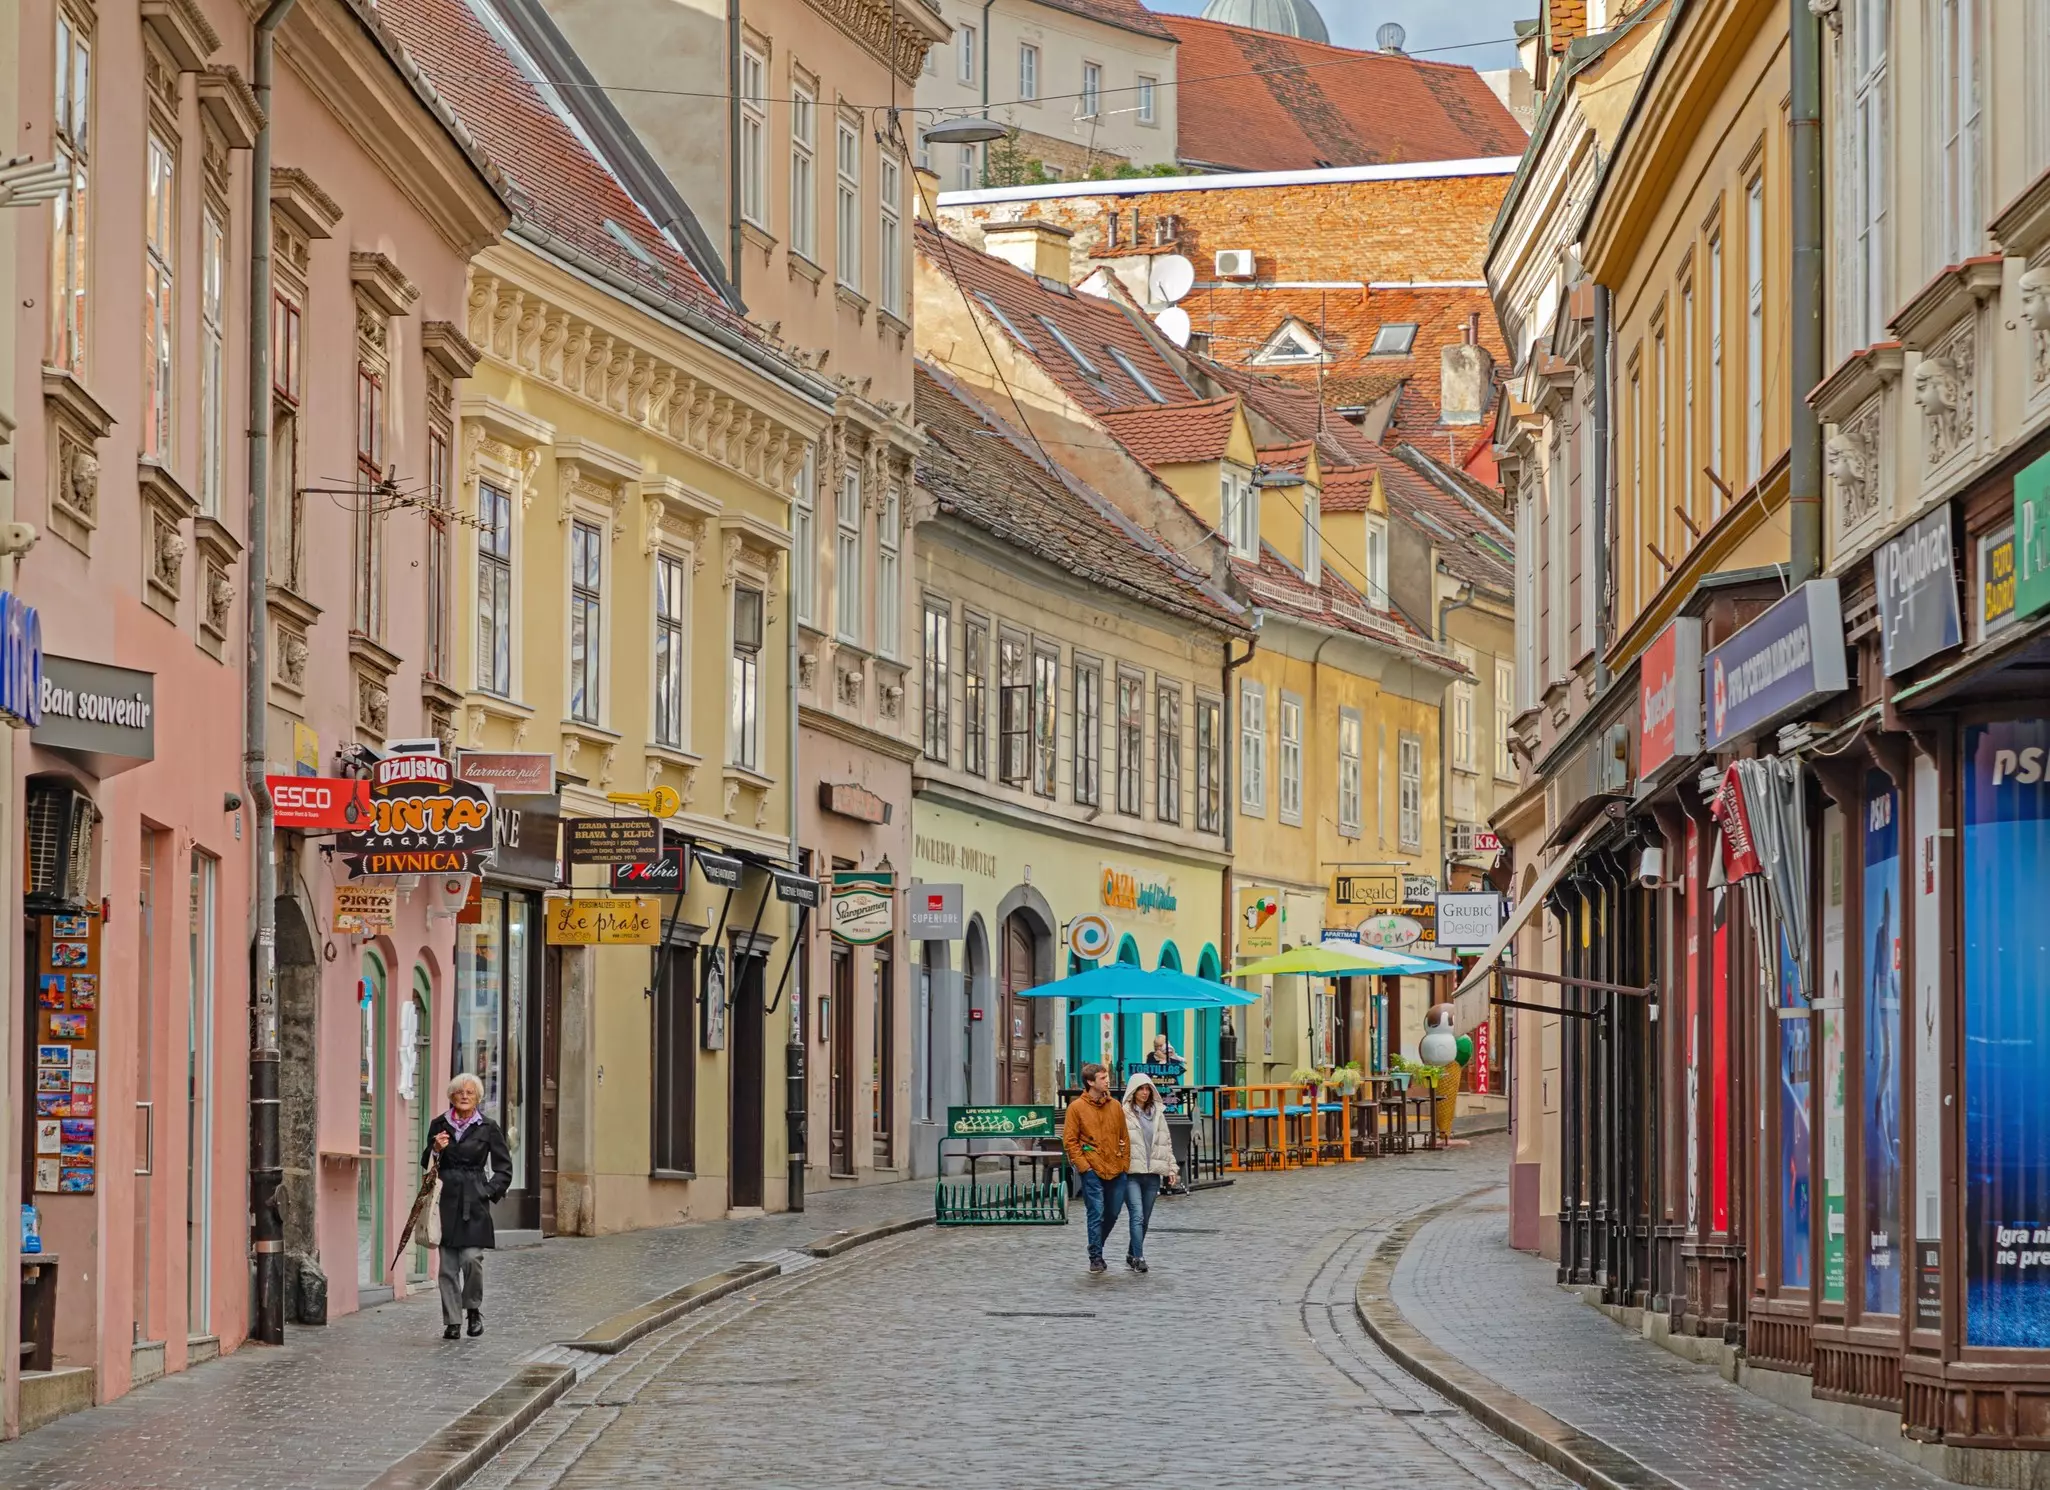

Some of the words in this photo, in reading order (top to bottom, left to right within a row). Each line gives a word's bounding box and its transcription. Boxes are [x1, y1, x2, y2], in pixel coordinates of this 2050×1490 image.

[41, 678, 74, 718] Ban
[78, 693, 150, 728] souvenir
[380, 757, 447, 784] Ožujsko
[464, 762, 517, 777] harmica
[516, 763, 544, 780] pub
[1992, 747, 2050, 786] PS
[274, 786, 331, 809] ESCO
[578, 822, 607, 830] IZRADA
[610, 820, 651, 829] KLJUČEVA
[575, 831, 607, 839] BRAVA
[611, 831, 620, 839] &
[623, 828, 655, 838] KLJUČ
[364, 834, 465, 849] ZAGREB
[372, 853, 460, 873] PIVNICA
[1404, 885, 1430, 899] pele
[338, 895, 392, 906] PINTA
[836, 901, 888, 920] Staropramen
[1411, 904, 1436, 916] ZLAT
[912, 913, 958, 923] SUPERIORE
[1378, 919, 1397, 930] LA
[1443, 921, 1493, 937] Design
[1478, 1026, 1487, 1092] KRAVATA
[1131, 1064, 1180, 1075] TORTILLAS
[1996, 1225, 2029, 1248] Igra
[1996, 1251, 2016, 1265] ne
